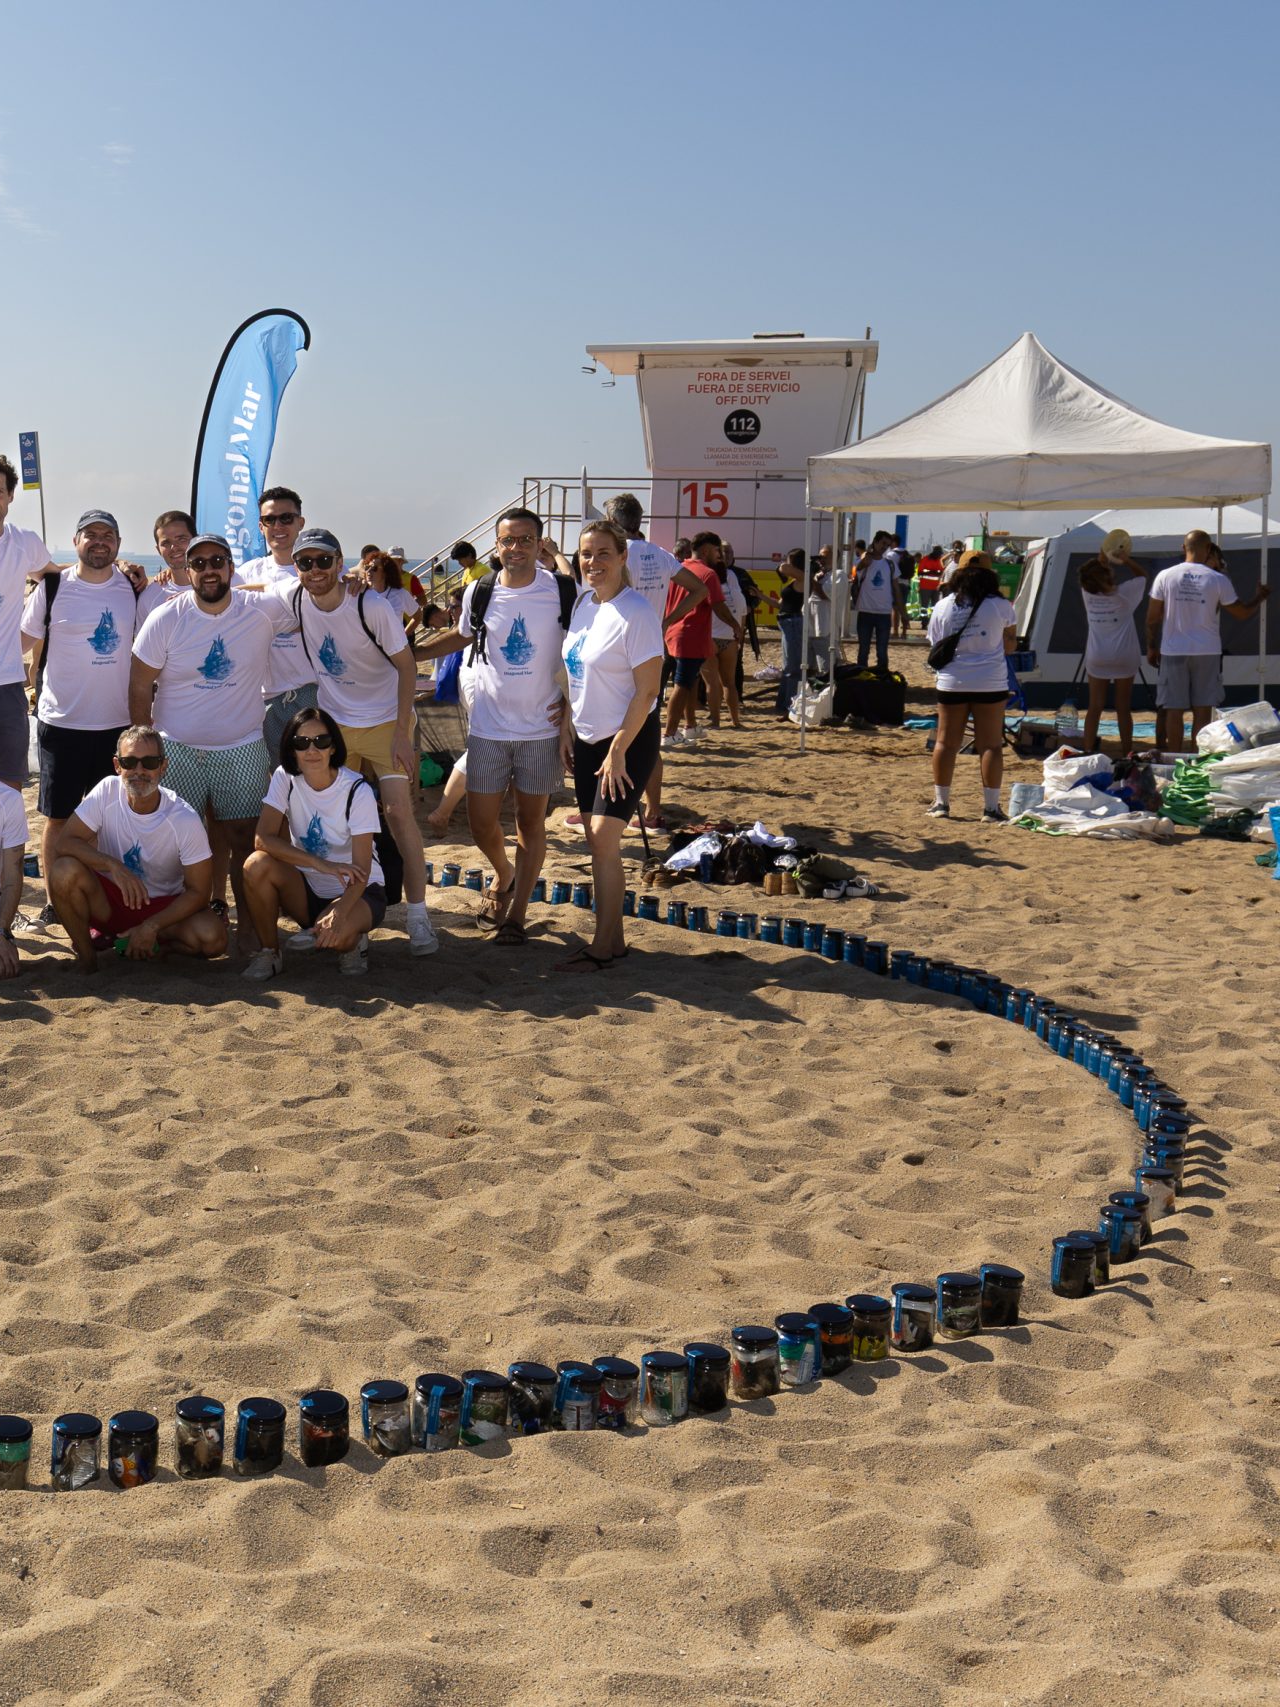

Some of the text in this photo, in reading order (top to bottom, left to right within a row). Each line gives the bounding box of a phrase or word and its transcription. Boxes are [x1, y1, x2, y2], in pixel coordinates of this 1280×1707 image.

[698, 371, 790, 382] FORA DE SERVEI
[687, 383, 800, 393] FUERA DE SERVICIO
[715, 395, 771, 405] OFF DUTY
[730, 417, 755, 430] 112
[224, 381, 261, 569] agonal Mar
[682, 482, 729, 517] 15
